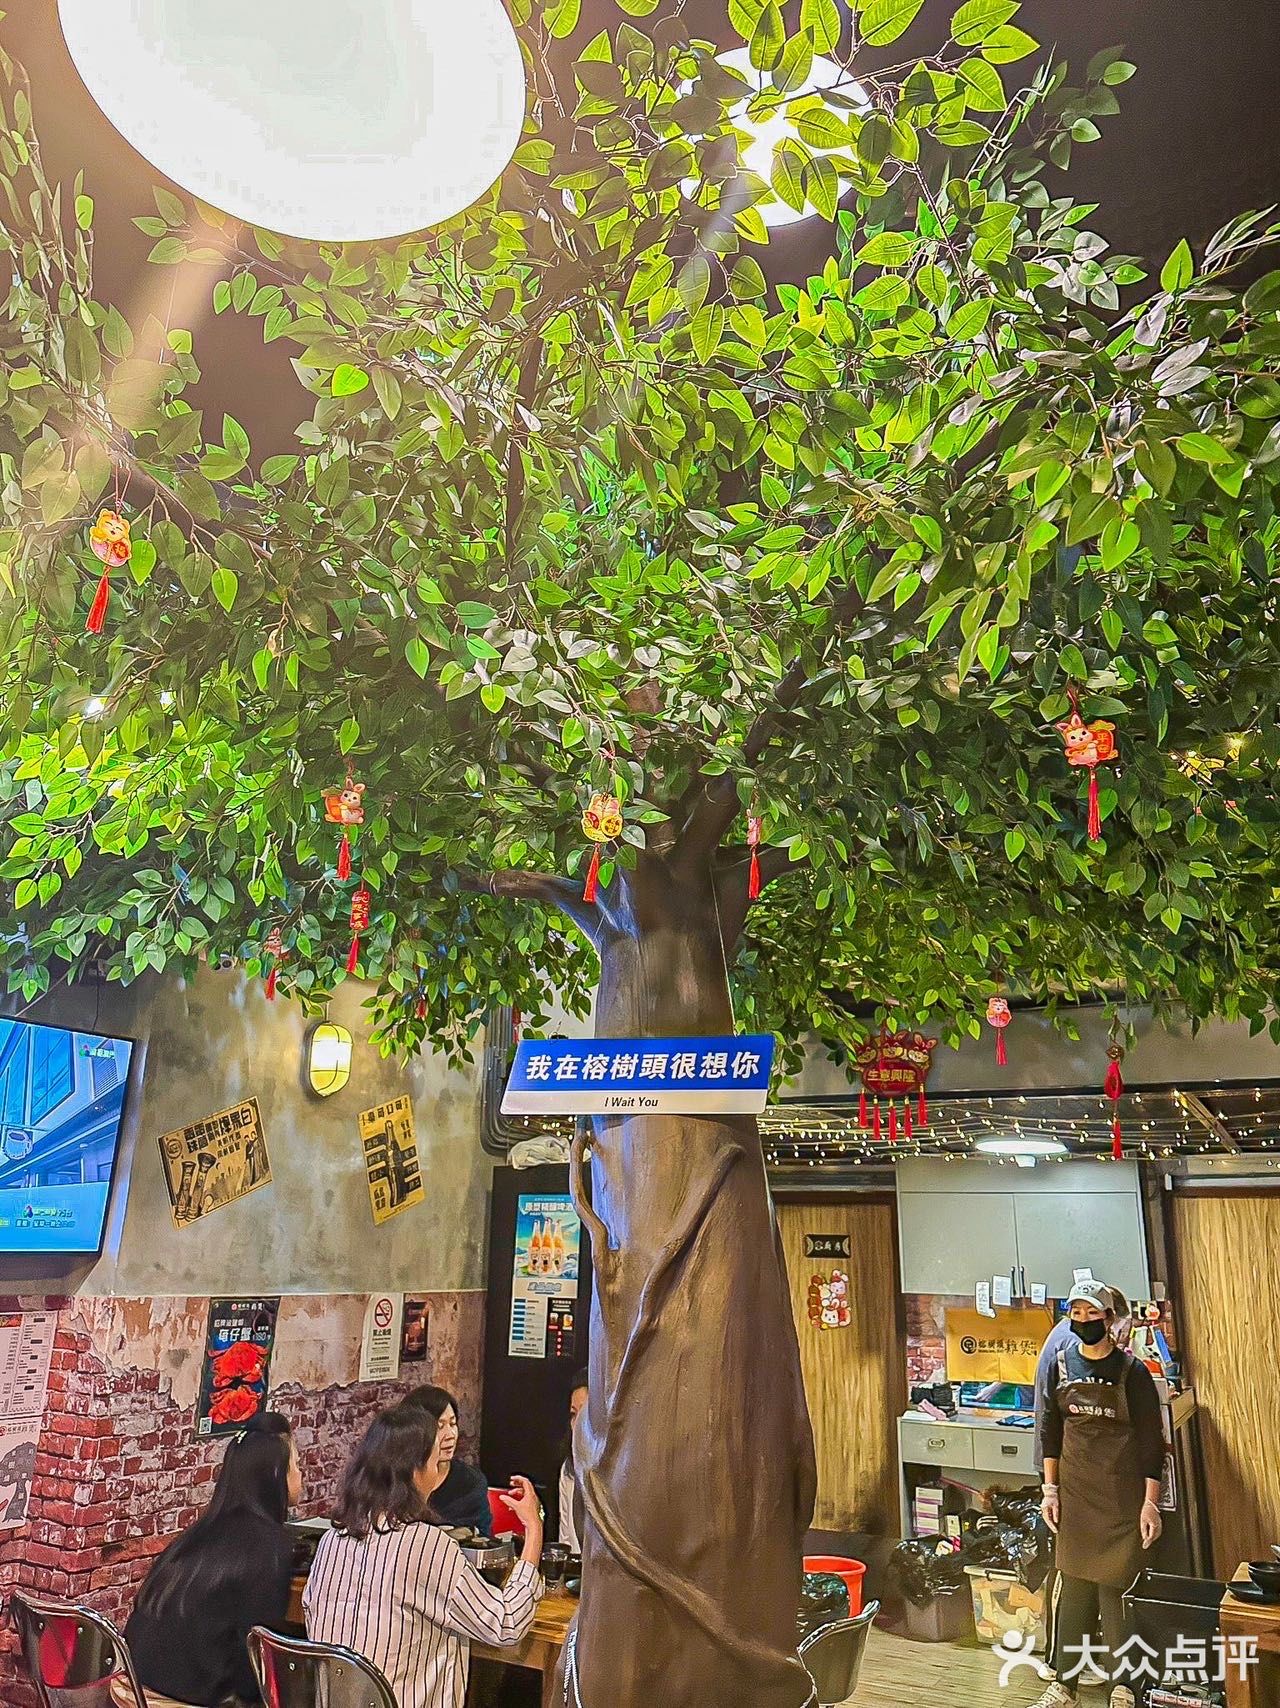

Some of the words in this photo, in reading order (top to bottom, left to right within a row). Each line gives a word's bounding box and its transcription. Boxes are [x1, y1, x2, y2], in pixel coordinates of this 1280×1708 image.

[525, 1051, 760, 1081] 我在榕樹頭很想你
[604, 1096, 609, 1107] I
[611, 1096, 635, 1107] Wait
[638, 1096, 658, 1107] You
